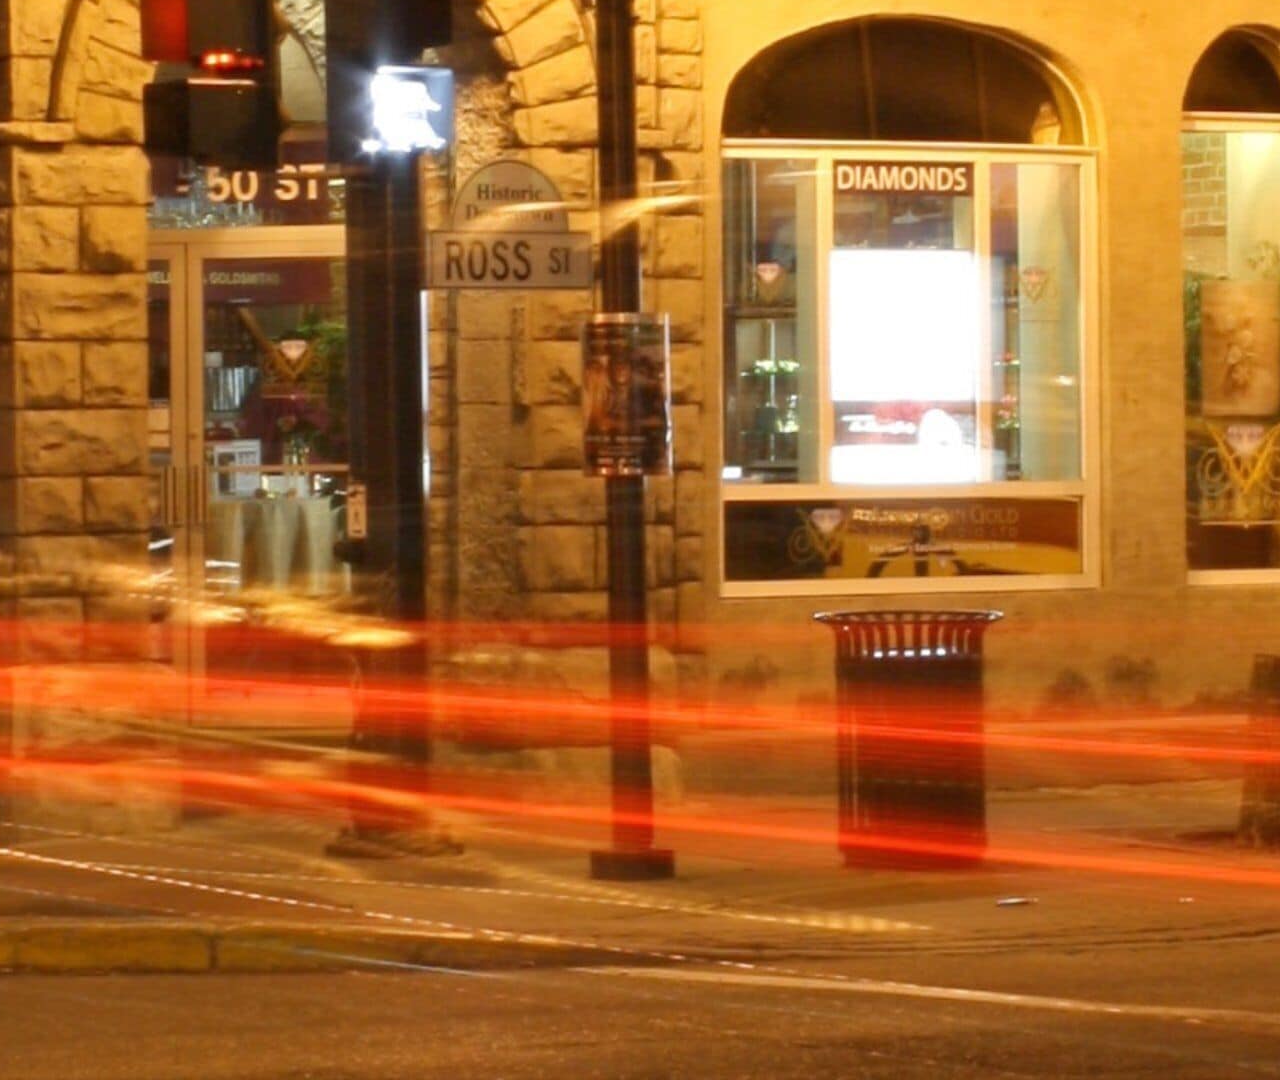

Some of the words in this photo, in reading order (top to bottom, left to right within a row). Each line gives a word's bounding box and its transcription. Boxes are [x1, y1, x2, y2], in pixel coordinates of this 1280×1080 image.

[204, 166, 259, 202] 50
[274, 164, 325, 201] ST
[477, 183, 542, 201] Historic
[836, 164, 968, 192] DIAMONDS
[445, 240, 532, 281] ROSS
[548, 247, 572, 275] ST
